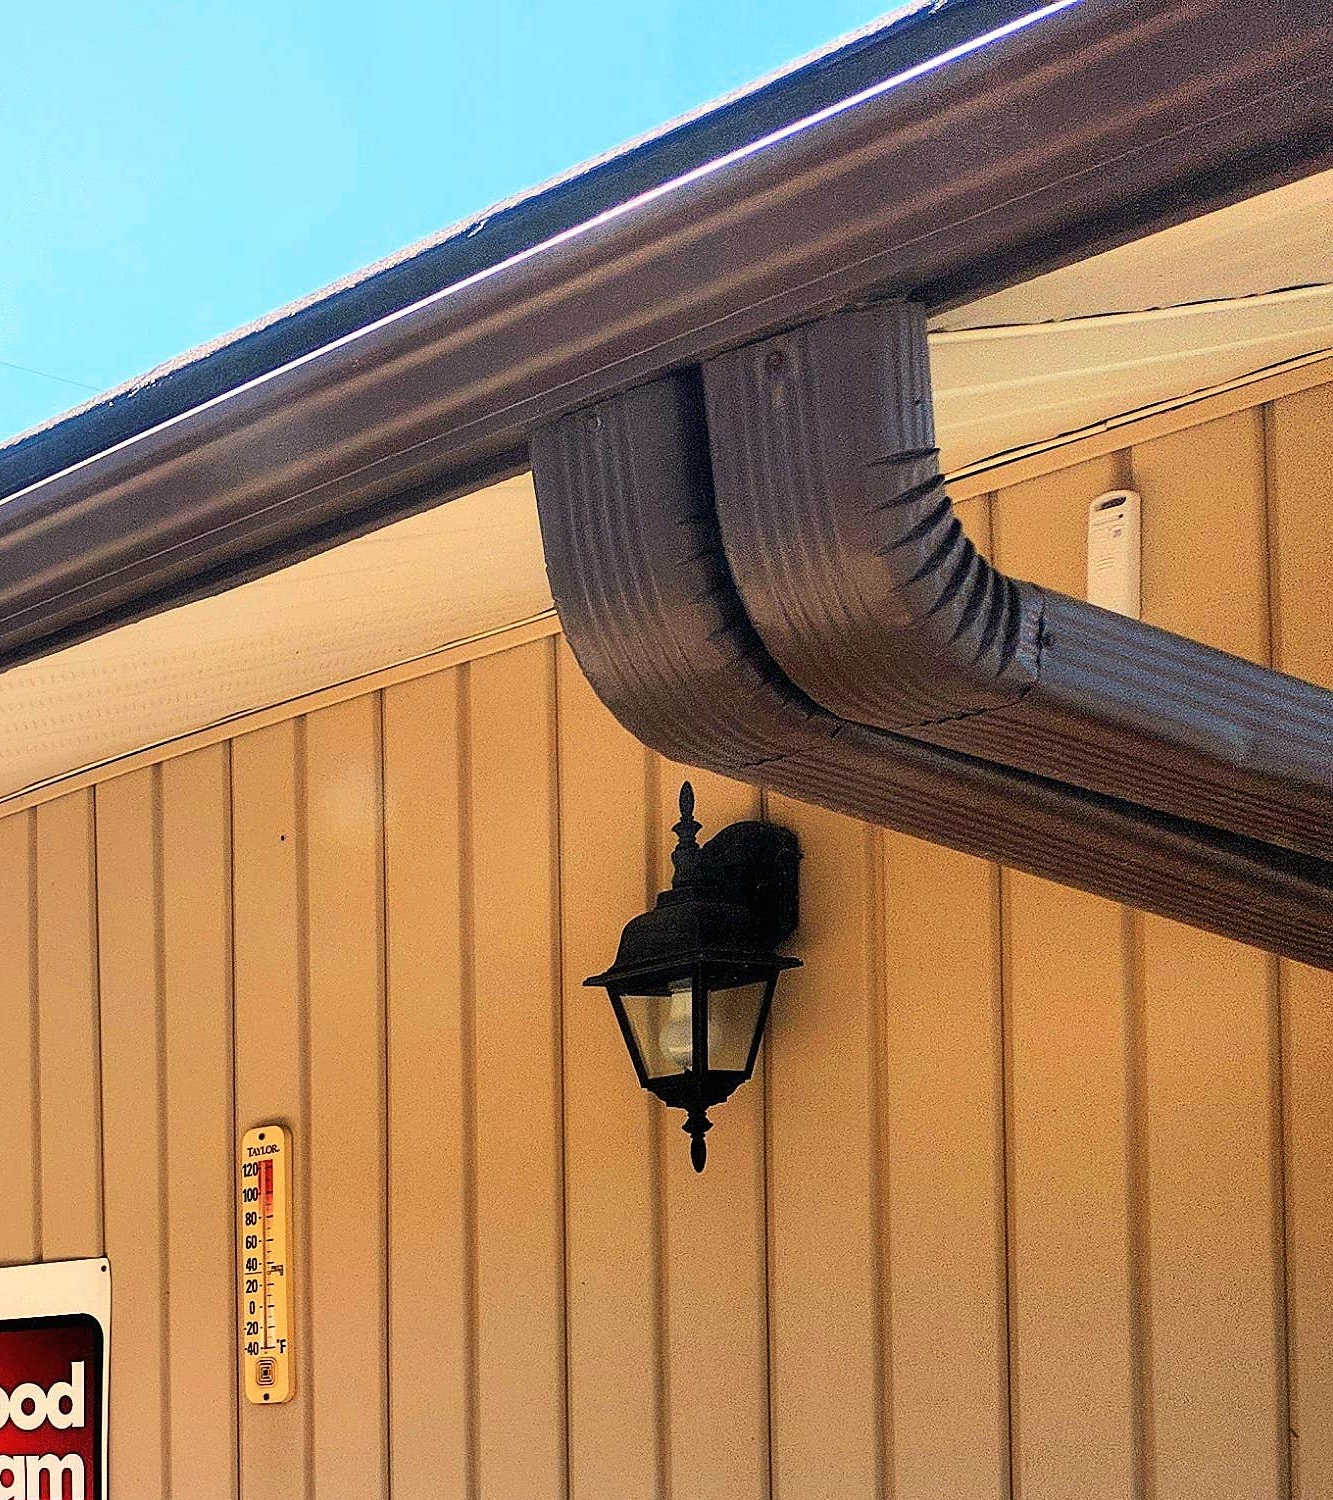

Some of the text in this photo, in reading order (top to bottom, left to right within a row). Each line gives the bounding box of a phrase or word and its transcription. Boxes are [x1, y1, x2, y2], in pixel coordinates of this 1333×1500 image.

[247, 1144, 280, 1157] TAYLOR
[243, 1162, 258, 1177] 120
[243, 1187, 258, 1202] 100
[245, 1212, 257, 1226] 80
[245, 1235, 257, 1249] 60
[245, 1257, 257, 1271] 40
[245, 1279, 258, 1293] 20
[249, 1301, 256, 1315] 0
